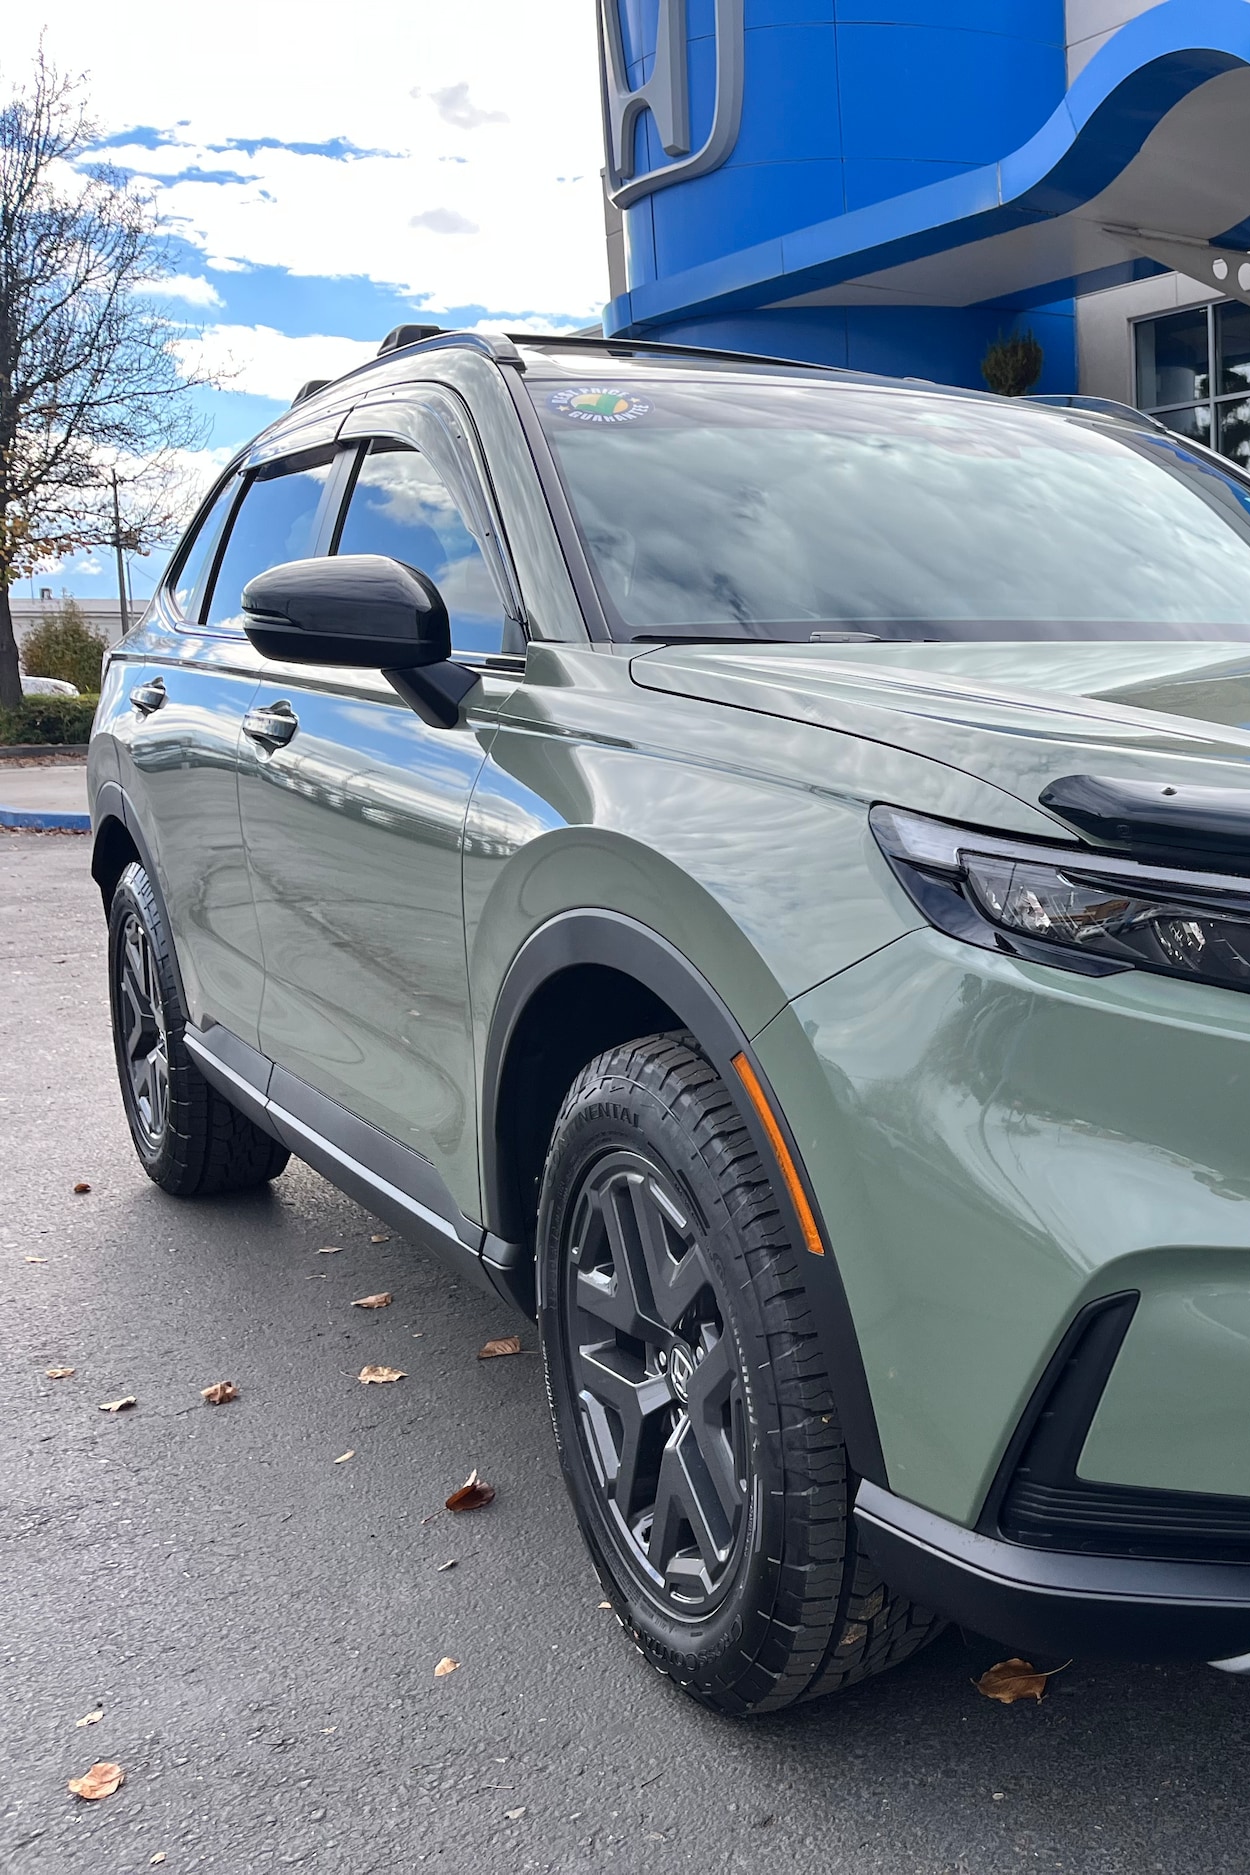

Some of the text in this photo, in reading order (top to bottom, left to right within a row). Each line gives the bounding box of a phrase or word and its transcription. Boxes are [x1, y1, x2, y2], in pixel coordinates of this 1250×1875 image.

[551, 387, 630, 404] BEST PRICE
[568, 403, 649, 422] GUARANTEE
